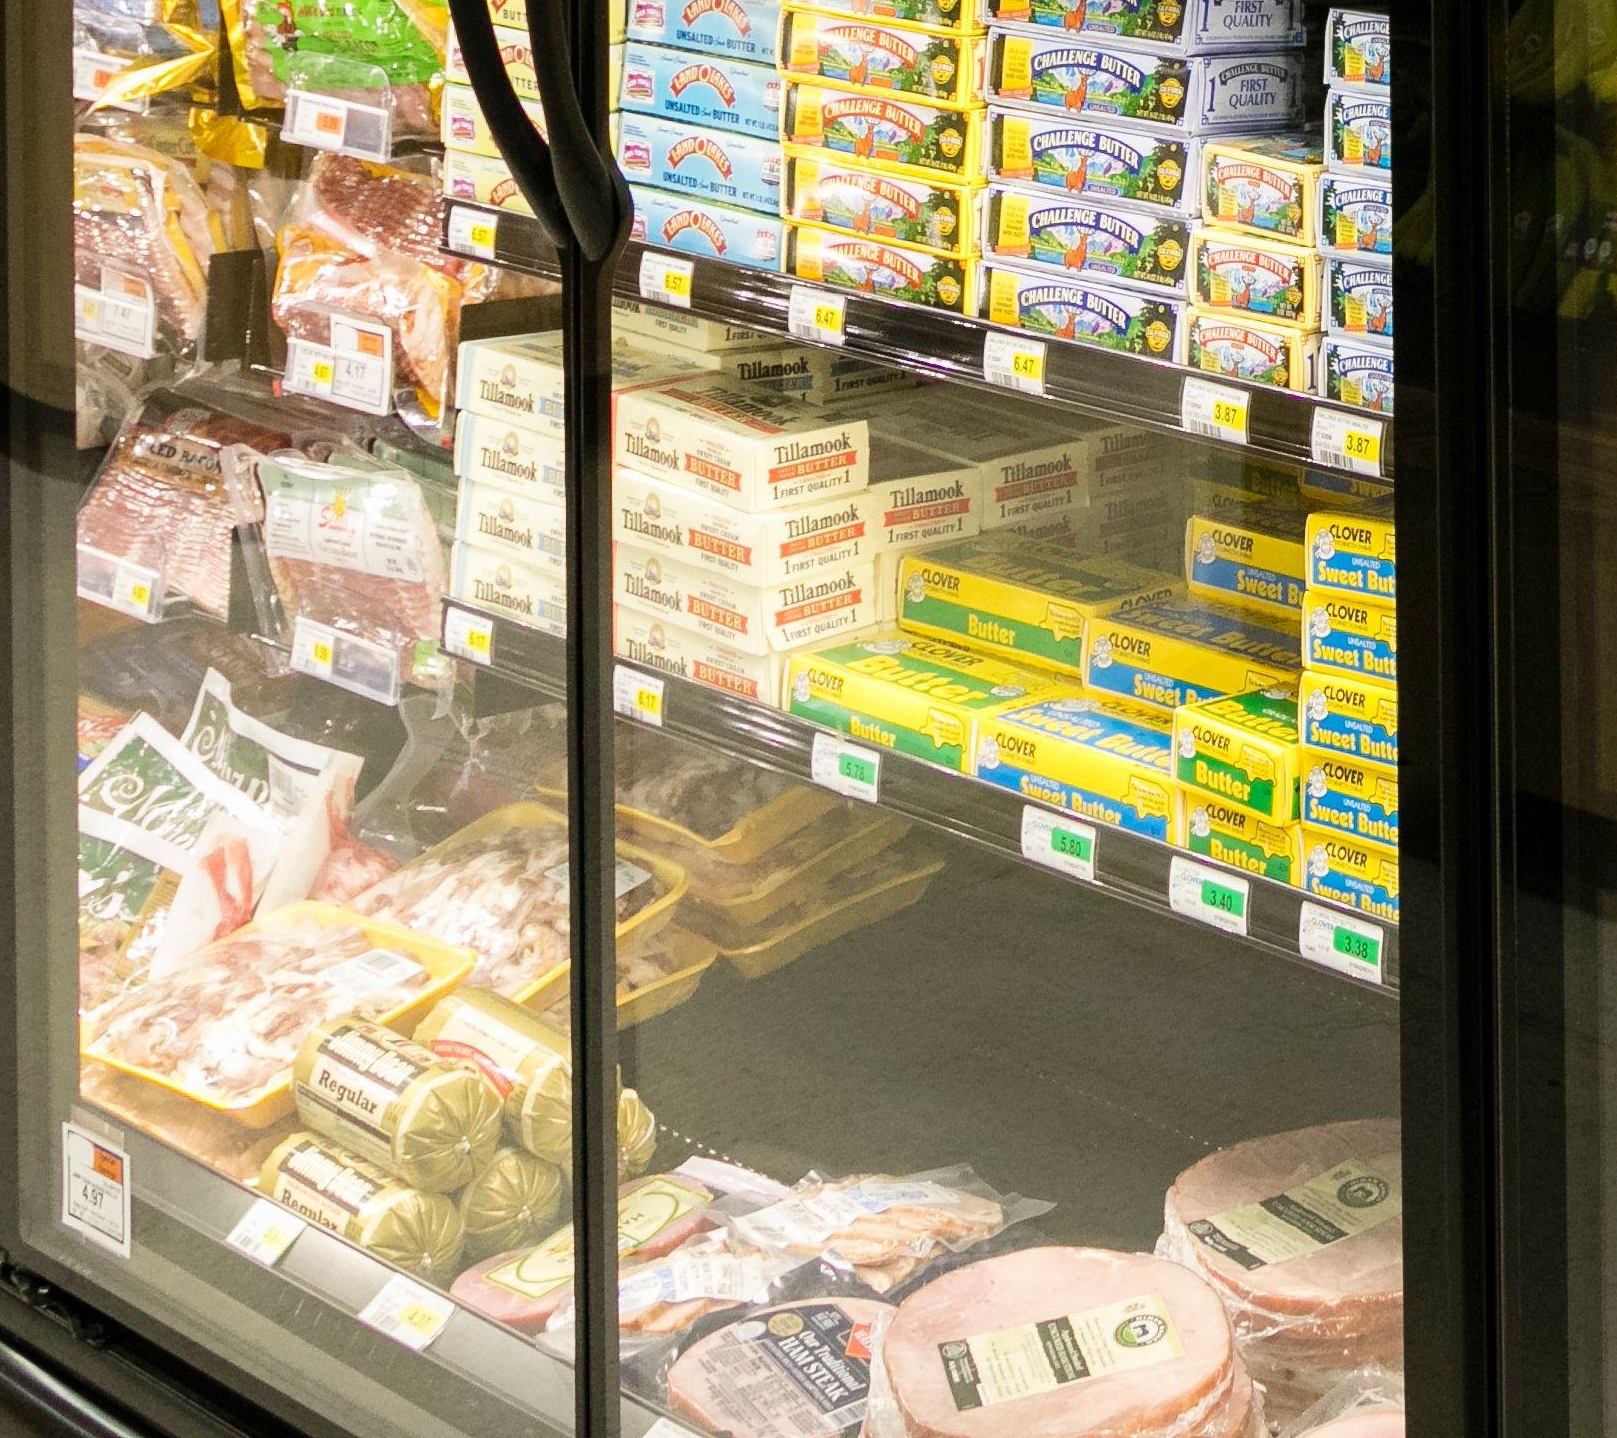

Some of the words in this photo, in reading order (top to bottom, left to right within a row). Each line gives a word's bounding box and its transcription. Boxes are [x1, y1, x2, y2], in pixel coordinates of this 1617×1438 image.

[774, 431, 852, 464] Tillamook
[797, 455, 847, 474] BUTTER
[842, 758, 867, 779] 5.78
[317, 1068, 379, 1118] Regular
